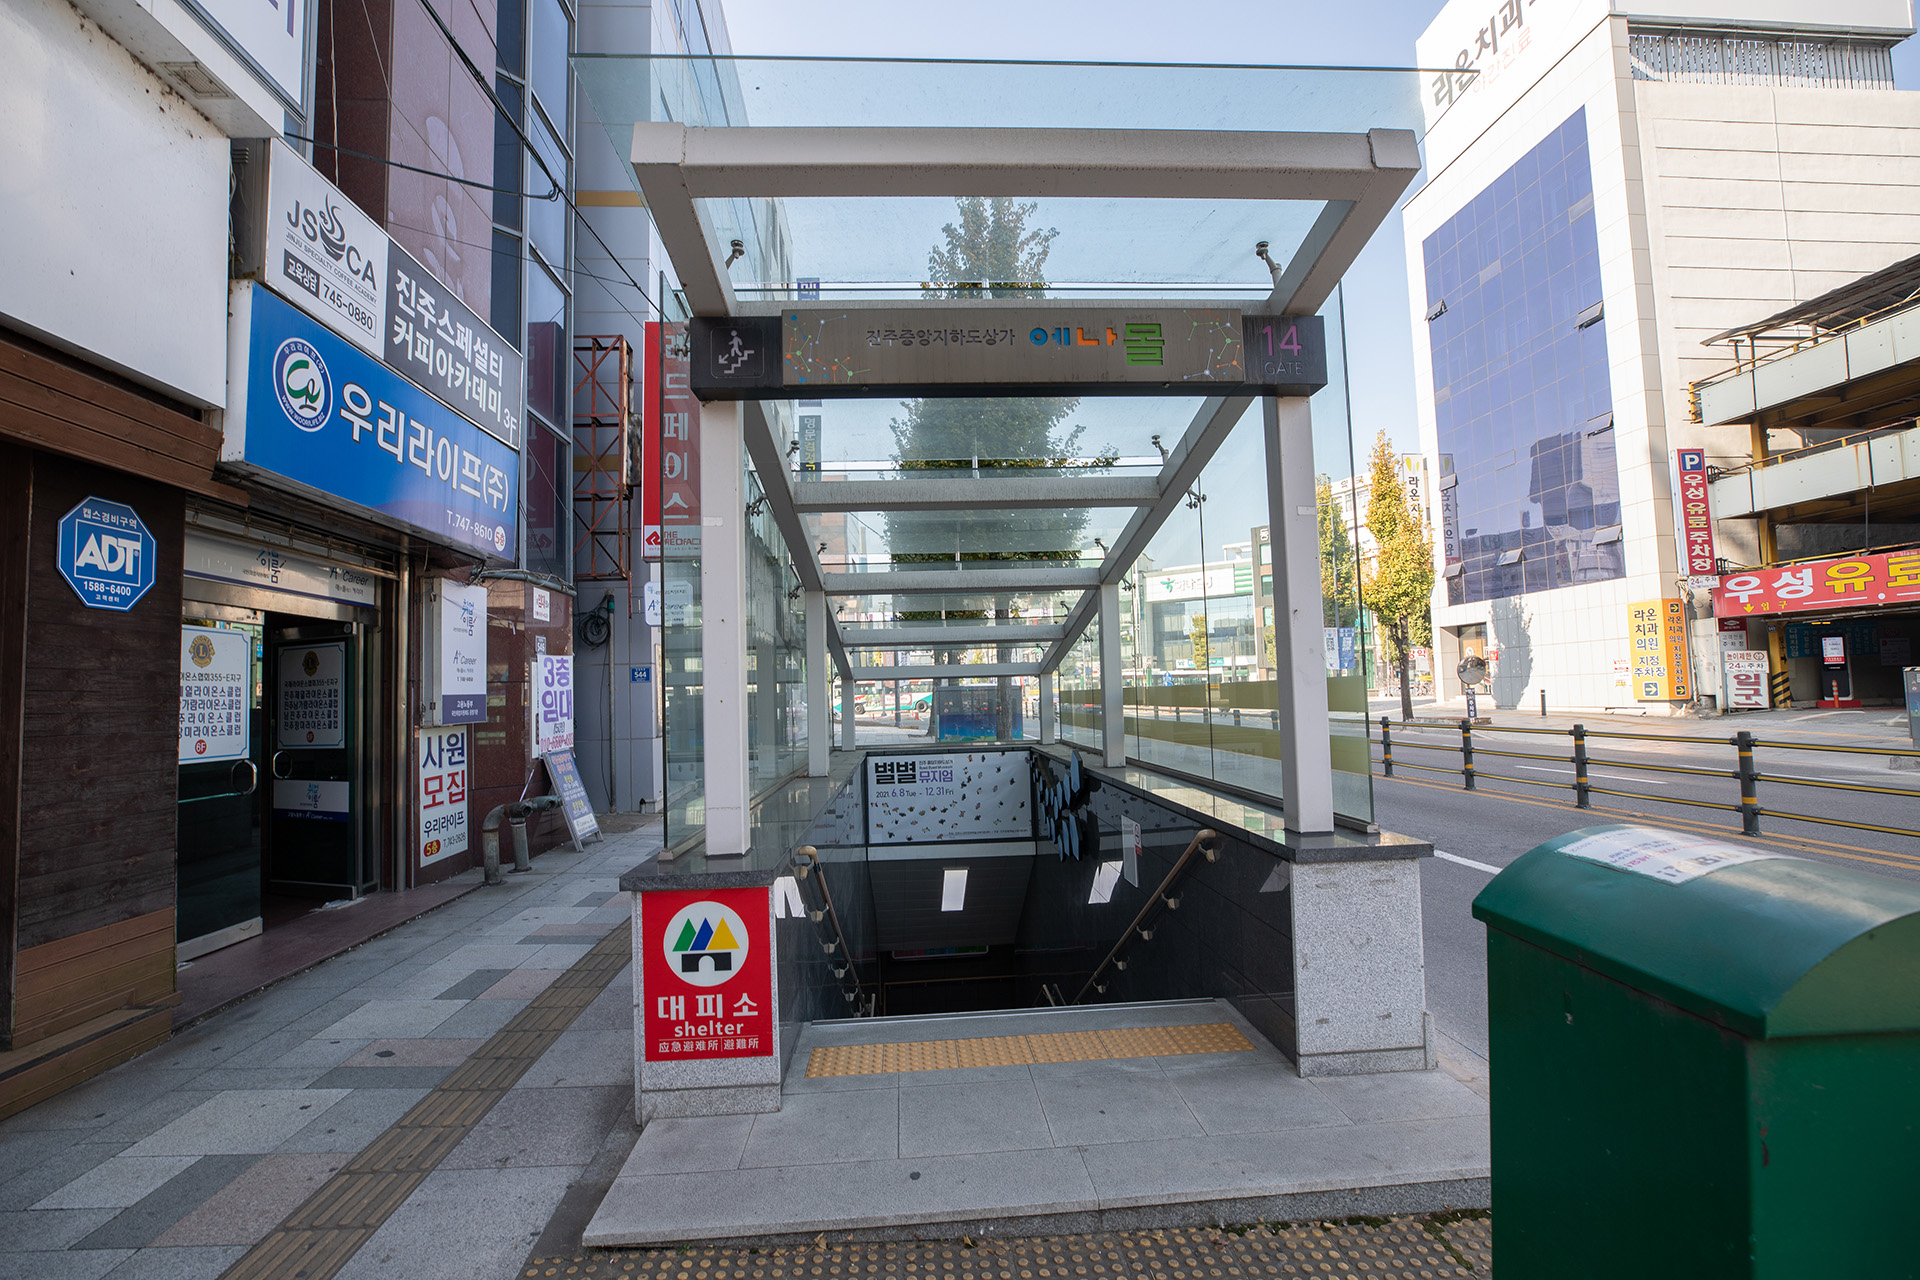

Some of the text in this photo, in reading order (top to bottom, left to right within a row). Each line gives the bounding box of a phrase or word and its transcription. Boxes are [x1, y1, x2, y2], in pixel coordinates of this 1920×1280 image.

[286, 232, 377, 304] JINJU SPECIALTY COFFEE ACADEMY
[287, 257, 373, 331] 교육상담 745-0880
[396, 269, 503, 387] 진주스페셜티
[866, 329, 1016, 347] 진주중앙지하도상가
[1262, 325, 1303, 357] 14
[1264, 362, 1303, 375] GATE
[393, 315, 518, 444] 커피아카데미 3F
[663, 334, 690, 519] 레드페이스
[340, 381, 509, 513] 우리라이프(주)
[1685, 454, 1700, 470] P
[447, 510, 506, 550] T.747-8610 5층
[76, 532, 141, 576] ADT
[342, 571, 369, 586] Career
[83, 580, 131, 596] 1588-6400
[1761, 600, 1788, 611] 입구
[1634, 608, 1657, 622] 라온
[1667, 616, 1683, 625] 라온
[1635, 623, 1659, 636] 치과
[1668, 625, 1683, 634] 치과
[1636, 637, 1659, 651] 의원
[1669, 635, 1684, 644] 의원
[461, 655, 477, 665] Career
[1638, 655, 1660, 666] 지정
[1726, 652, 1752, 660] 높이제한
[543, 657, 570, 688] 3층
[634, 671, 647, 679] 544
[1634, 666, 1666, 678] 주차장
[541, 689, 572, 723] 임대
[196, 742, 206, 753] 6F
[422, 732, 465, 769] 사원
[875, 761, 954, 785] 별별 뮤지엄
[423, 769, 466, 810] 모집
[424, 811, 465, 838] 우리라이프
[426, 841, 438, 856] 5층
[657, 993, 759, 1021] 대피소
[674, 1020, 744, 1037] shelter
[659, 1037, 759, 1053] 应急避难所 避難所
